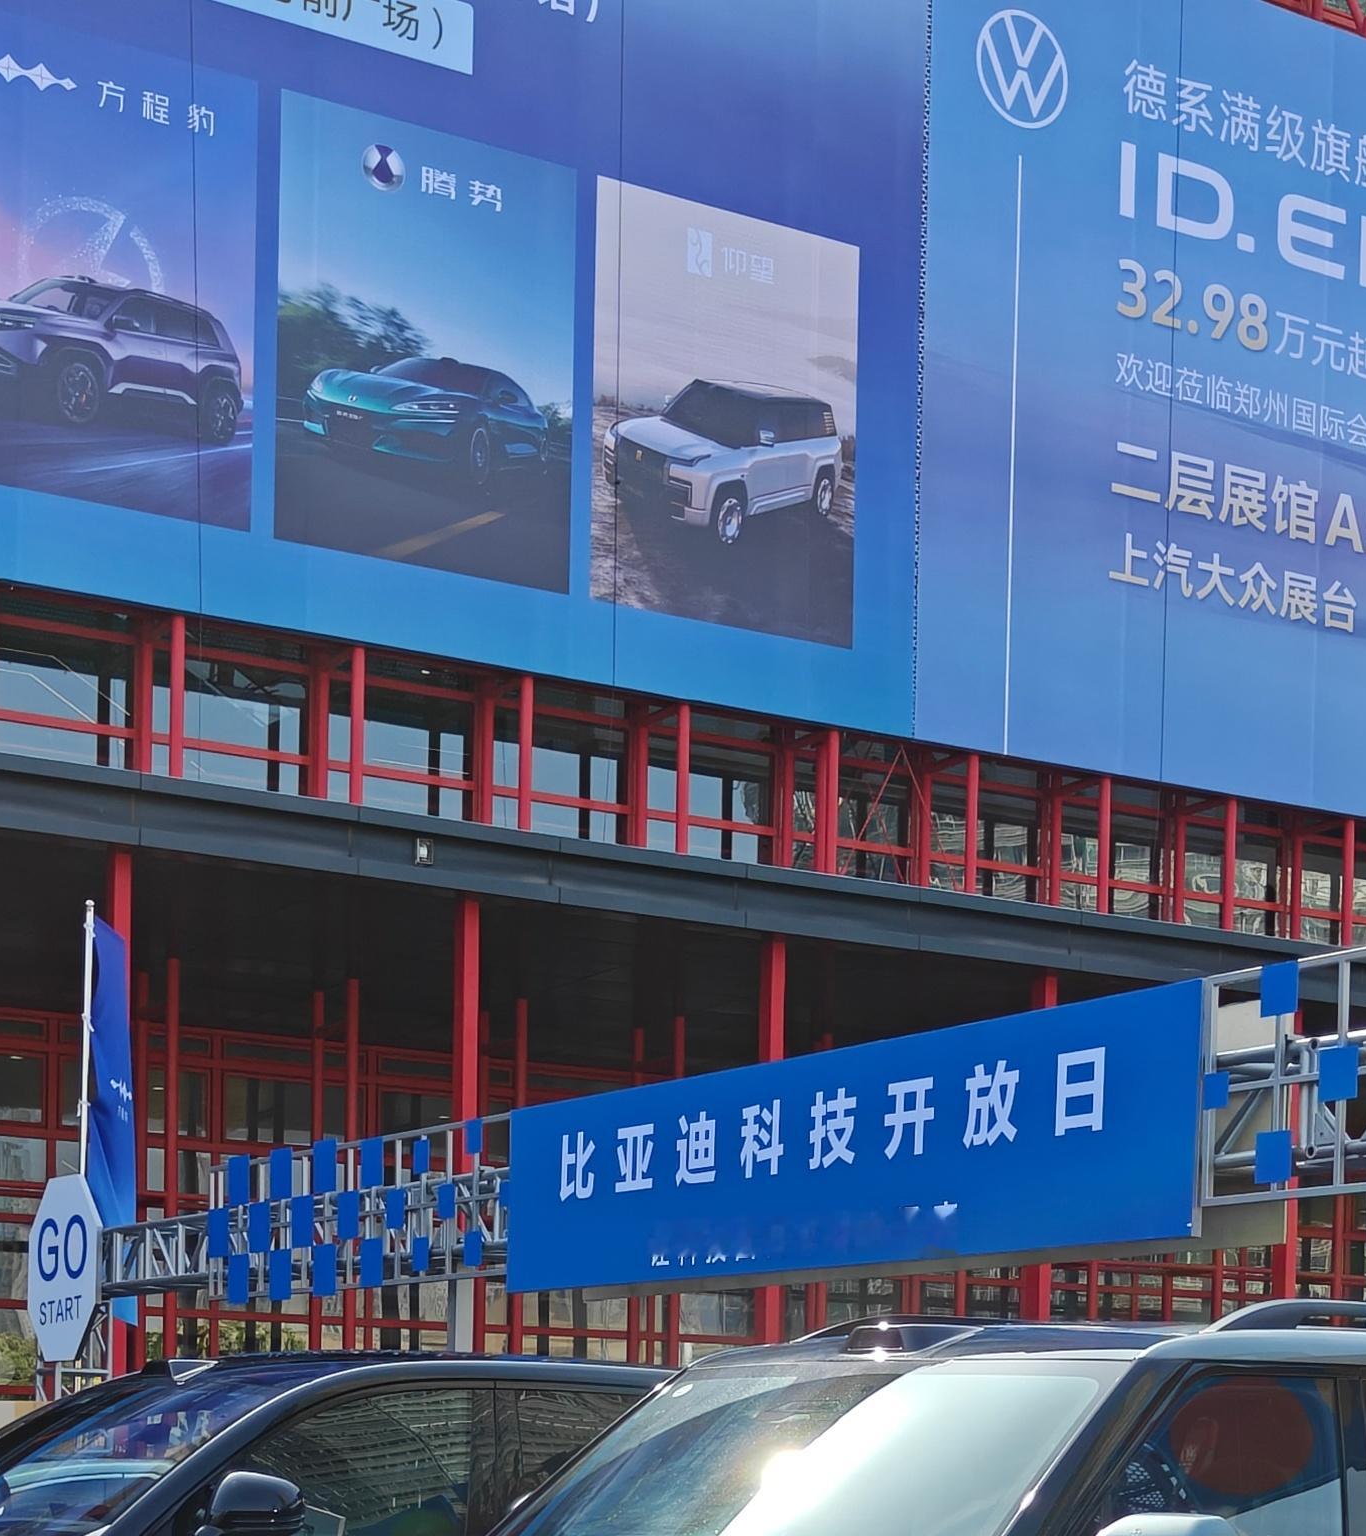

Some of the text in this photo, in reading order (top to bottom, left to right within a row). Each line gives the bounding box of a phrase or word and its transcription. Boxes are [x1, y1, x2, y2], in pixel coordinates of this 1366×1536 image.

[97, 80, 215, 137] 方程豹
[420, 165, 503, 213] 腾势
[721, 245, 776, 286] 仰望
[1108, 532, 1358, 634] 上汽大众展台
[558, 1046, 1108, 1203] 比亚迪科技开放日
[37, 1213, 88, 1283] GO
[38, 1293, 84, 1326] START
